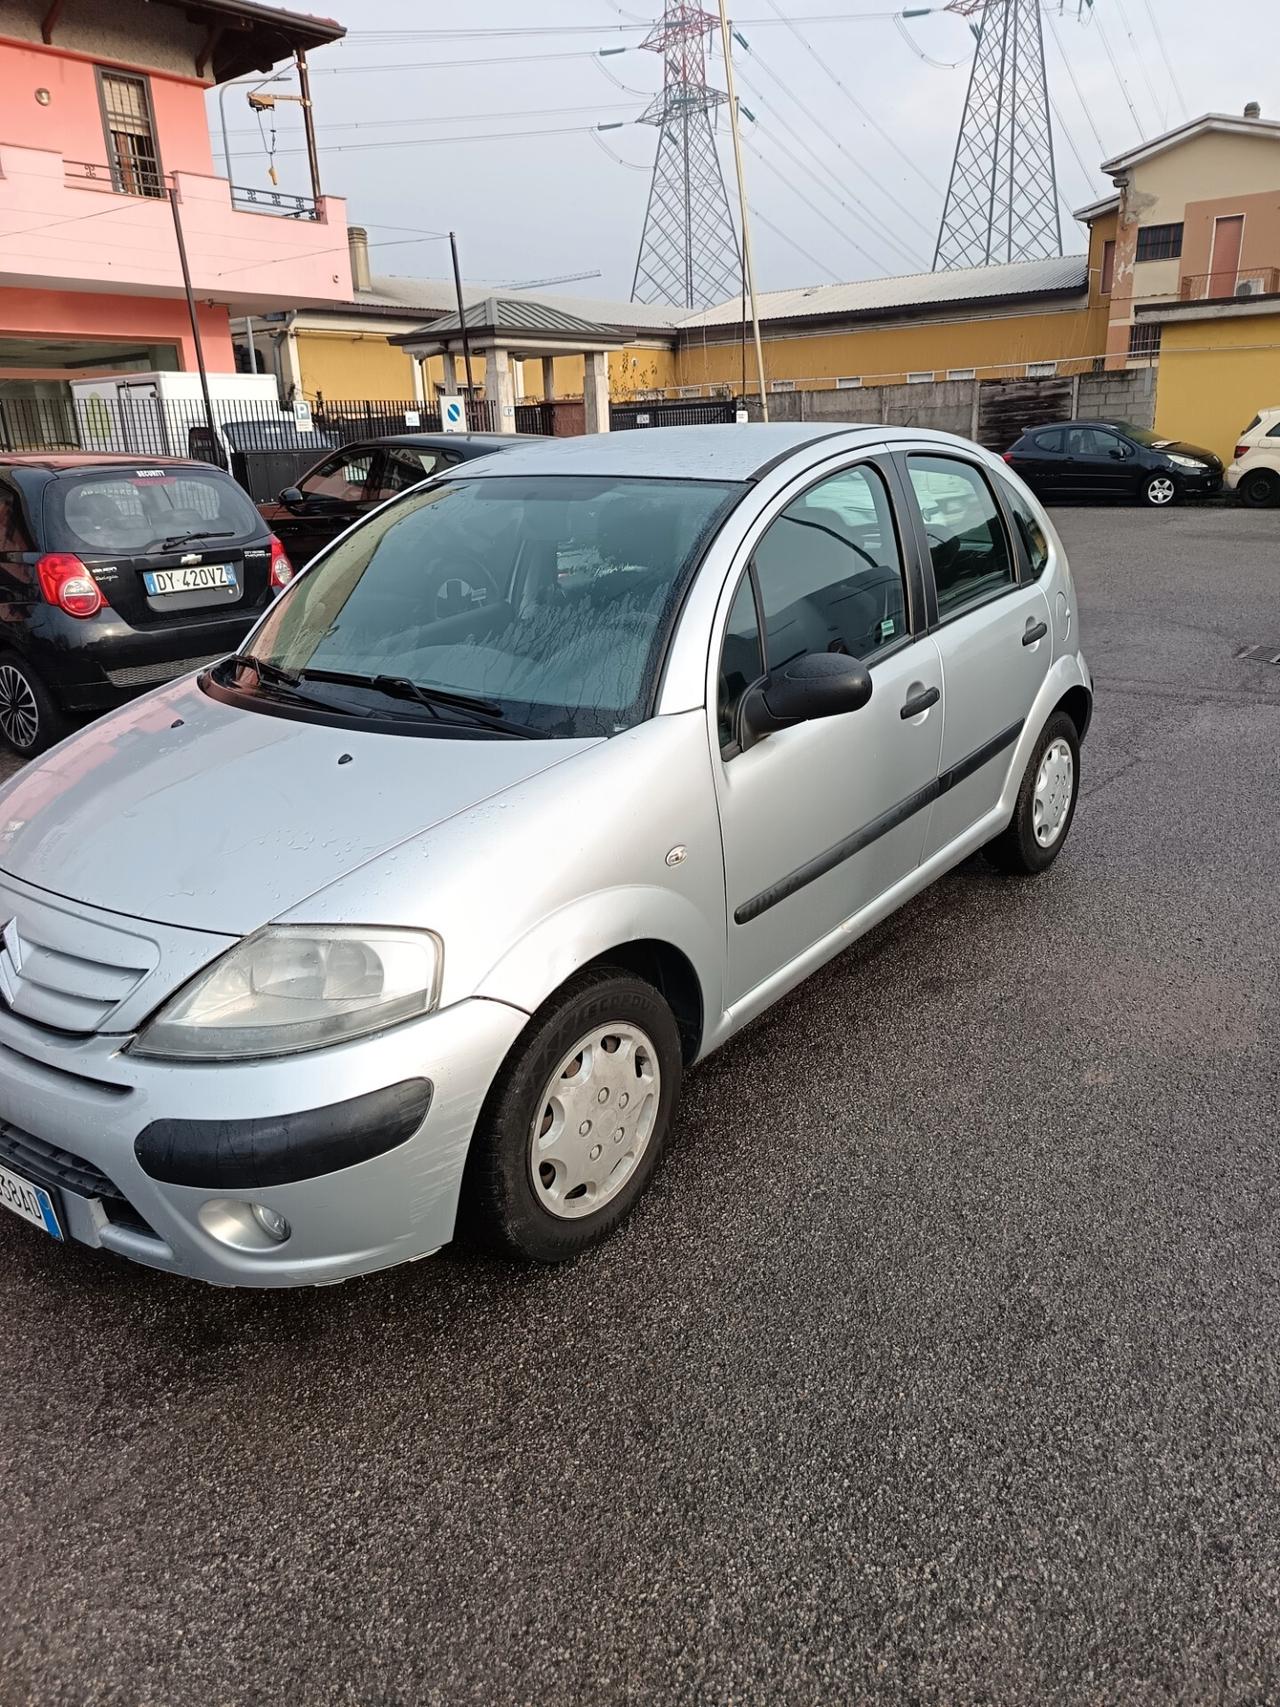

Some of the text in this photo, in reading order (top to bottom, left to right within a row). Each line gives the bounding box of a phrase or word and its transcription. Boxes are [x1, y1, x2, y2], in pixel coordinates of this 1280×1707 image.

[136, 469, 166, 478] SECURITY
[156, 572, 175, 591] DY
[182, 567, 227, 587] 420VZ
[0, 1174, 42, 1220] 38AD
